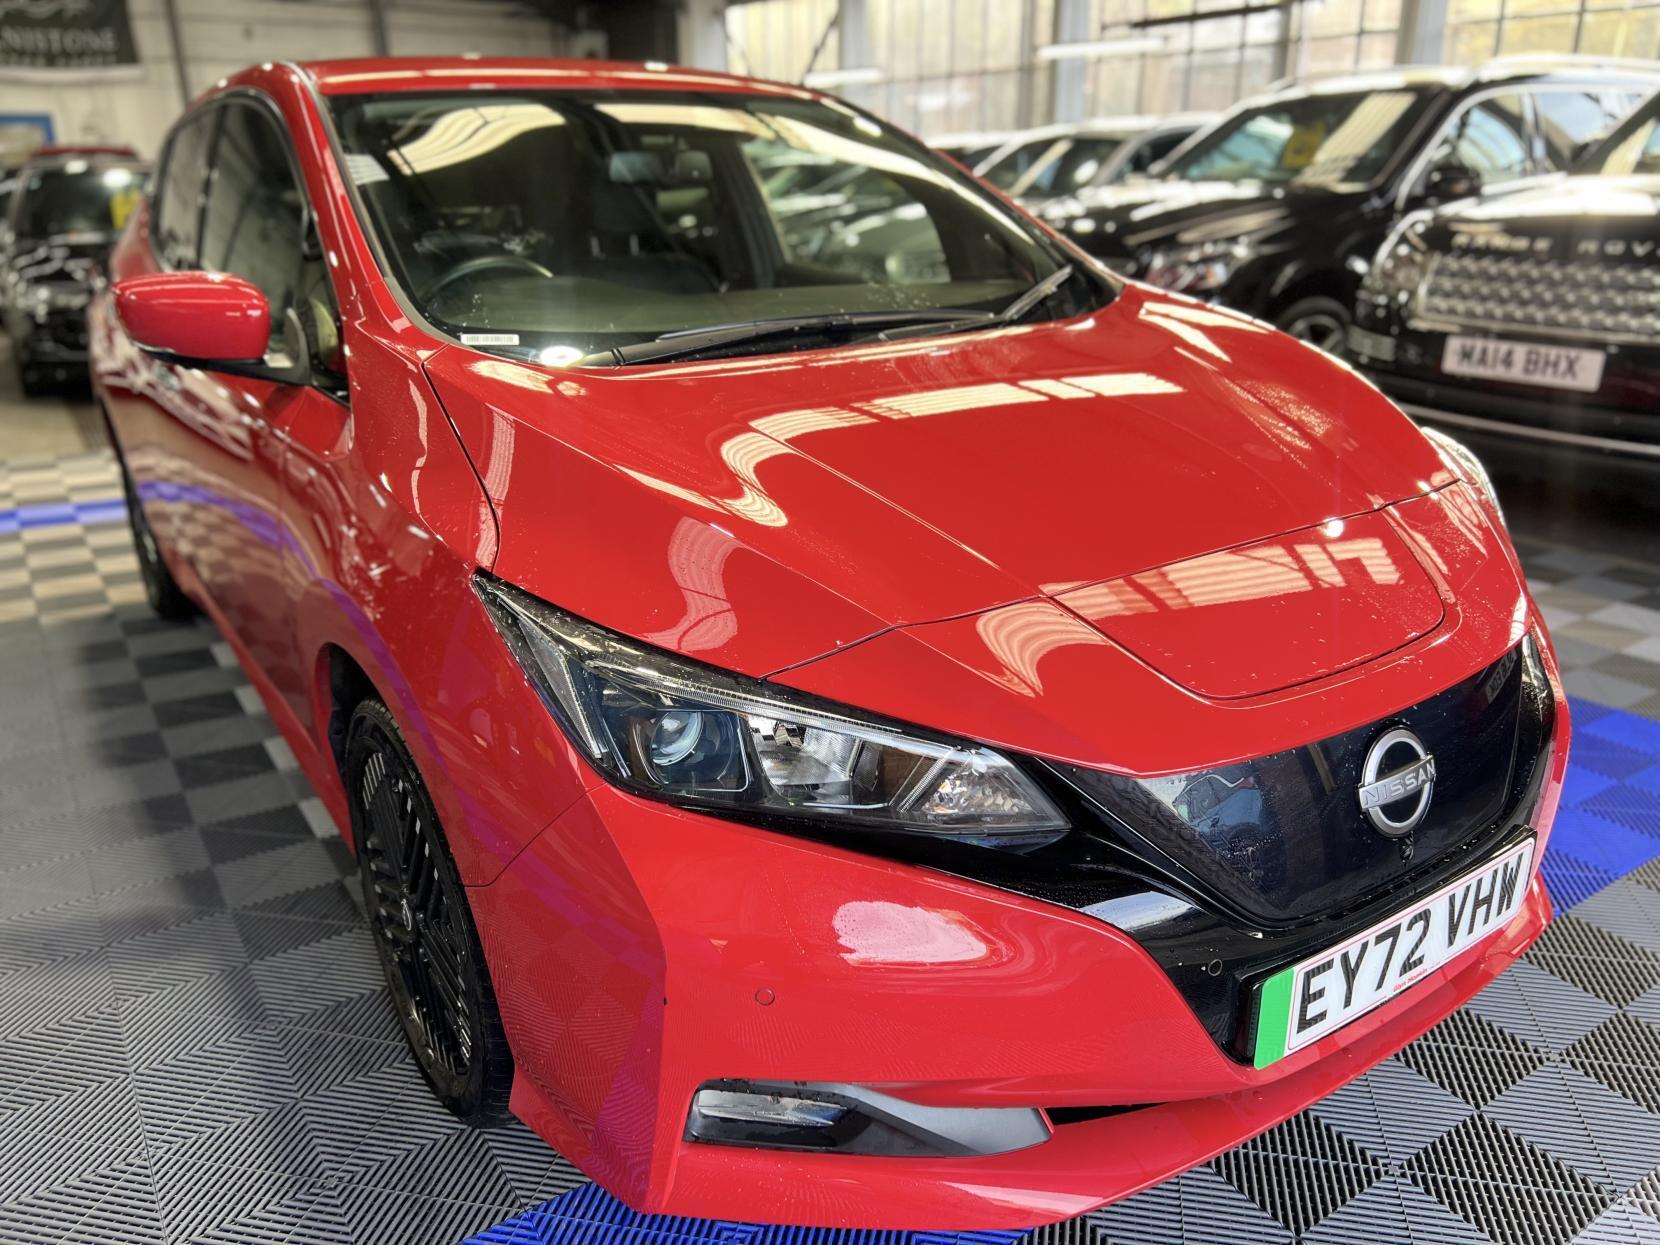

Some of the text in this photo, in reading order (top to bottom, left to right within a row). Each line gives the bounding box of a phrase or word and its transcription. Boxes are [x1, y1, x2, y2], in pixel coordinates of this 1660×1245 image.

[1523, 349, 1581, 380] BHX
[1363, 757, 1436, 806] NISSAN
[1296, 852, 1524, 1034] EY72 VHW
